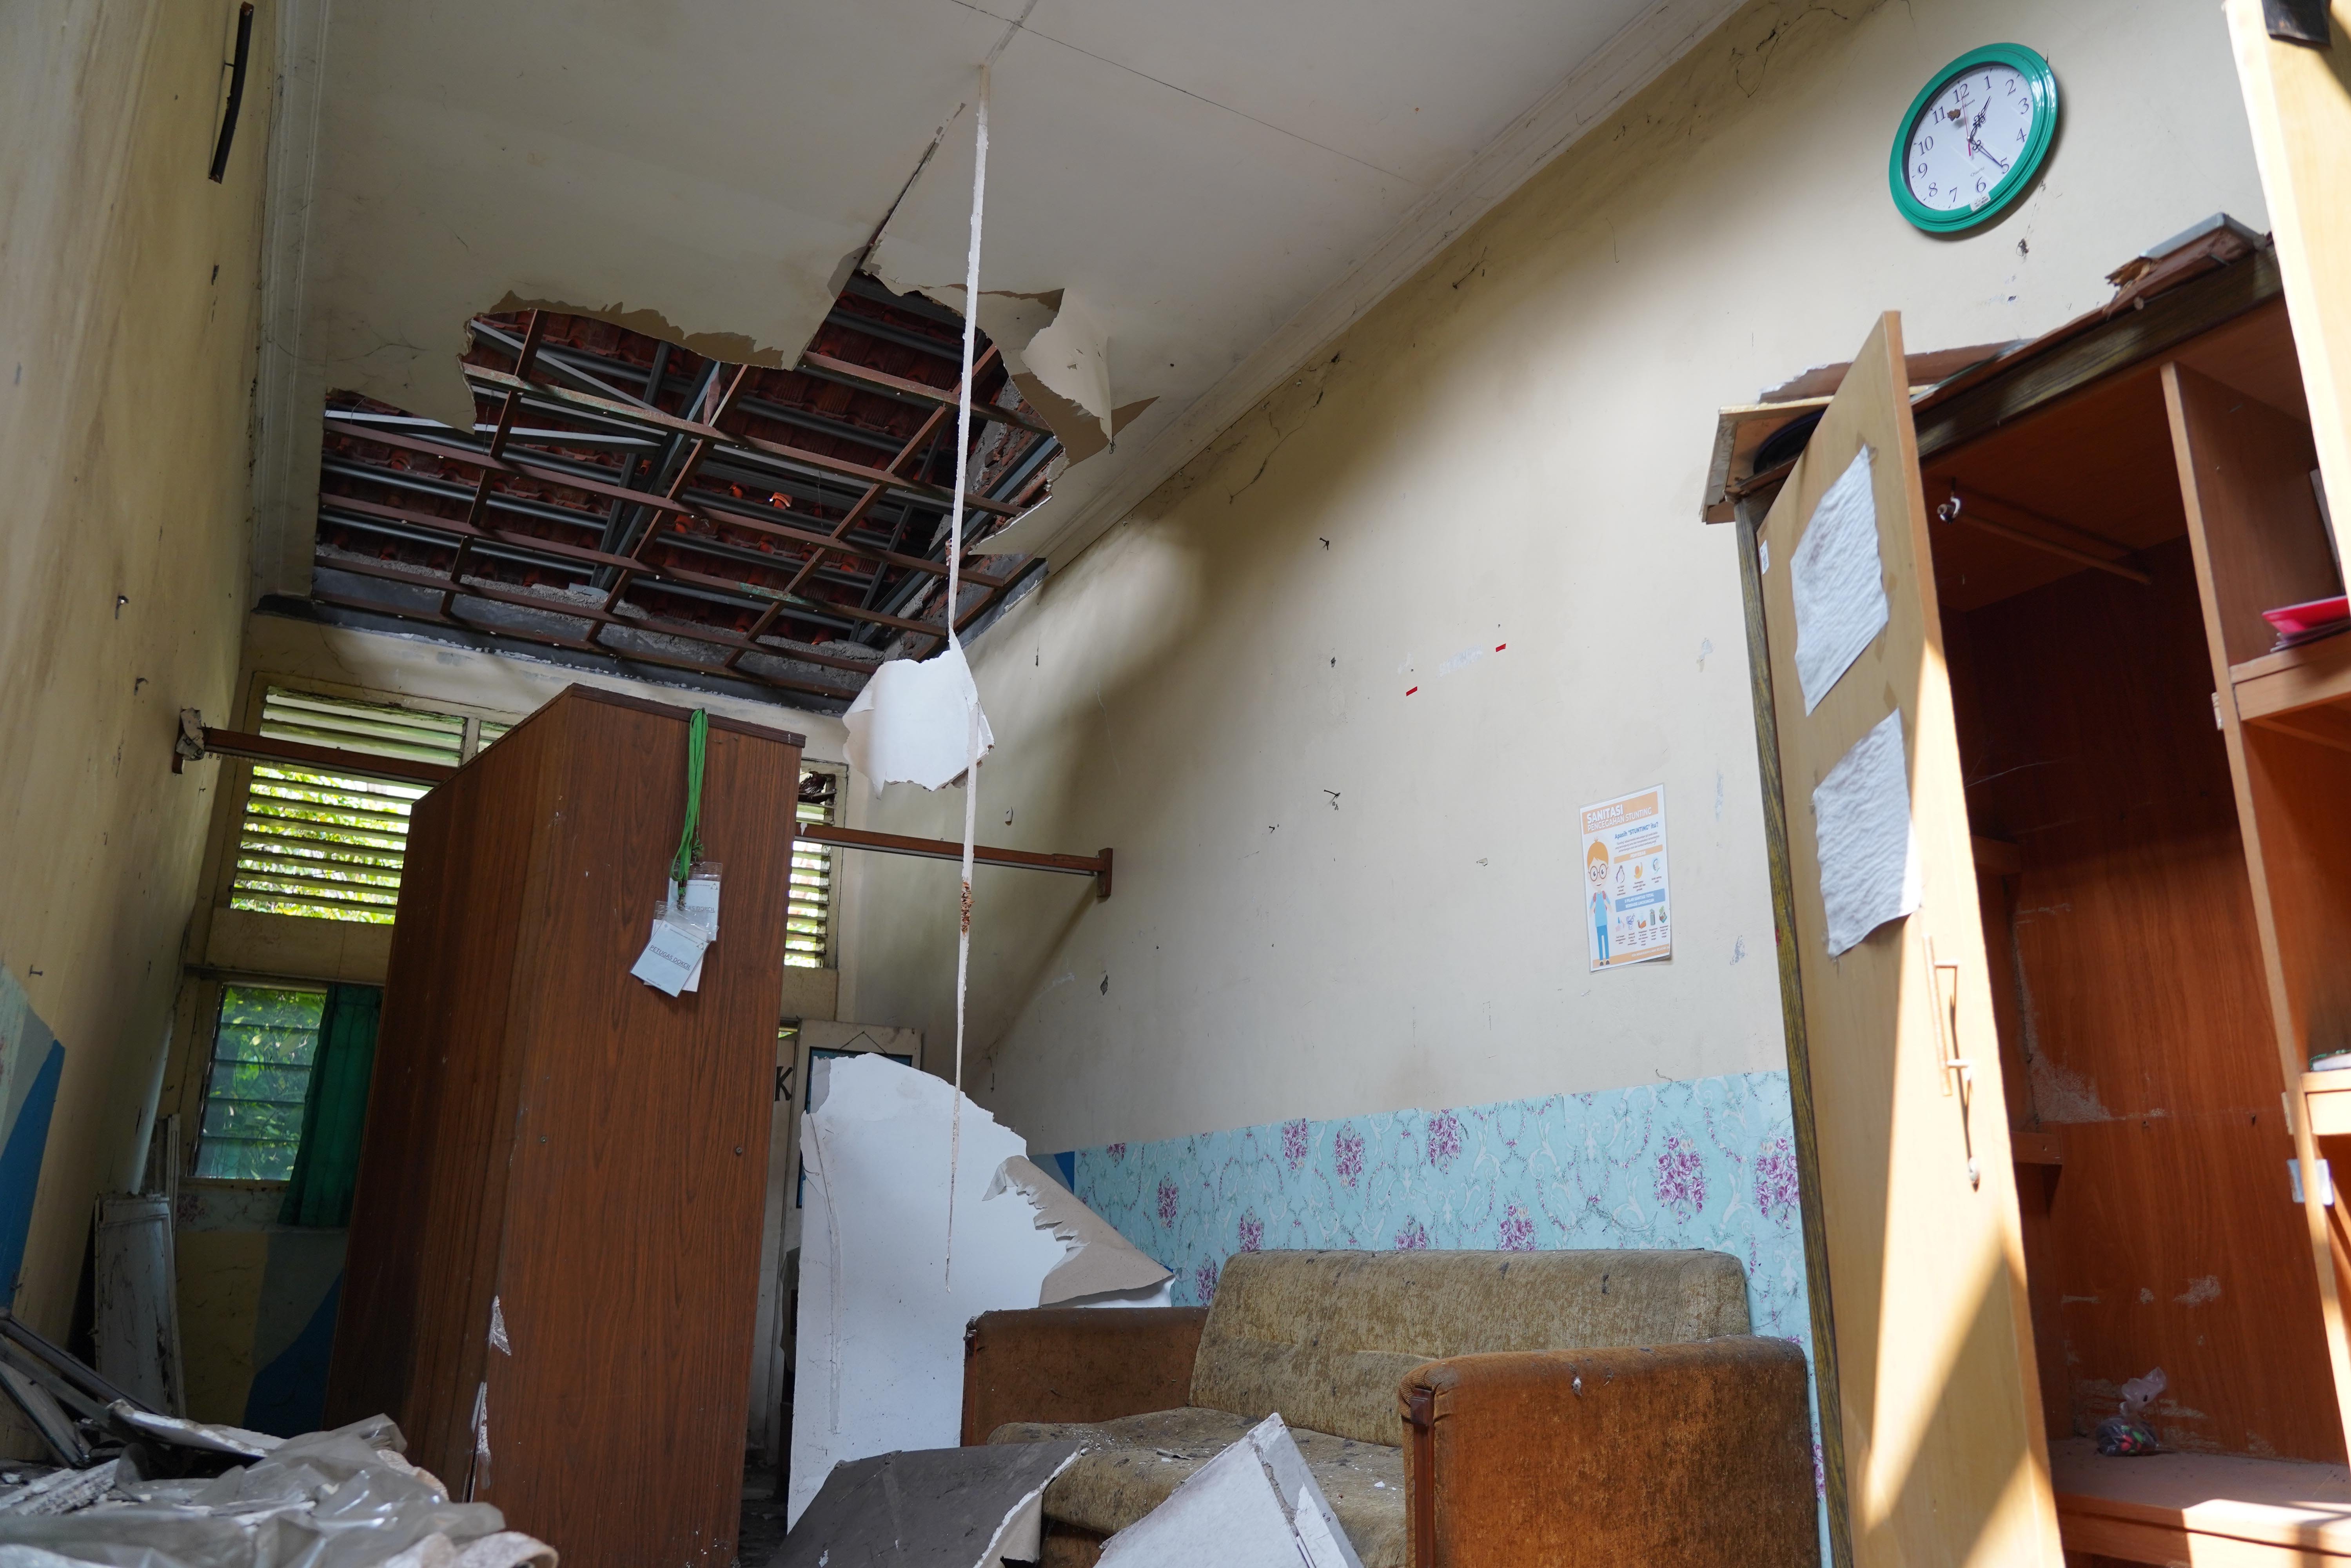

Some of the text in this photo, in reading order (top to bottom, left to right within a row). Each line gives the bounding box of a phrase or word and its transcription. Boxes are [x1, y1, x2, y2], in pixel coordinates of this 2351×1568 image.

[1984, 75, 1992, 91] 1
[2005, 79, 2016, 96] 2
[1953, 83, 1970, 104] 12
[1932, 105, 1946, 125] 11
[2018, 98, 2029, 115] 3
[2016, 127, 2026, 143] 4
[1918, 136, 1933, 156] 10
[1918, 163, 1928, 179] 9
[2001, 157, 2010, 174] 5
[1929, 182, 1938, 197] 8
[1975, 176, 1986, 193] 6
[1949, 187, 1957, 203] 7
[1587, 804, 1623, 824] SANITASI
[1587, 807, 1652, 832] PENCEGAHAN STUNTING
[1615, 831, 1627, 840] Apasih
[650, 945, 691, 970] PETUGAS DOKCIL
[775, 1066, 793, 1102] K
